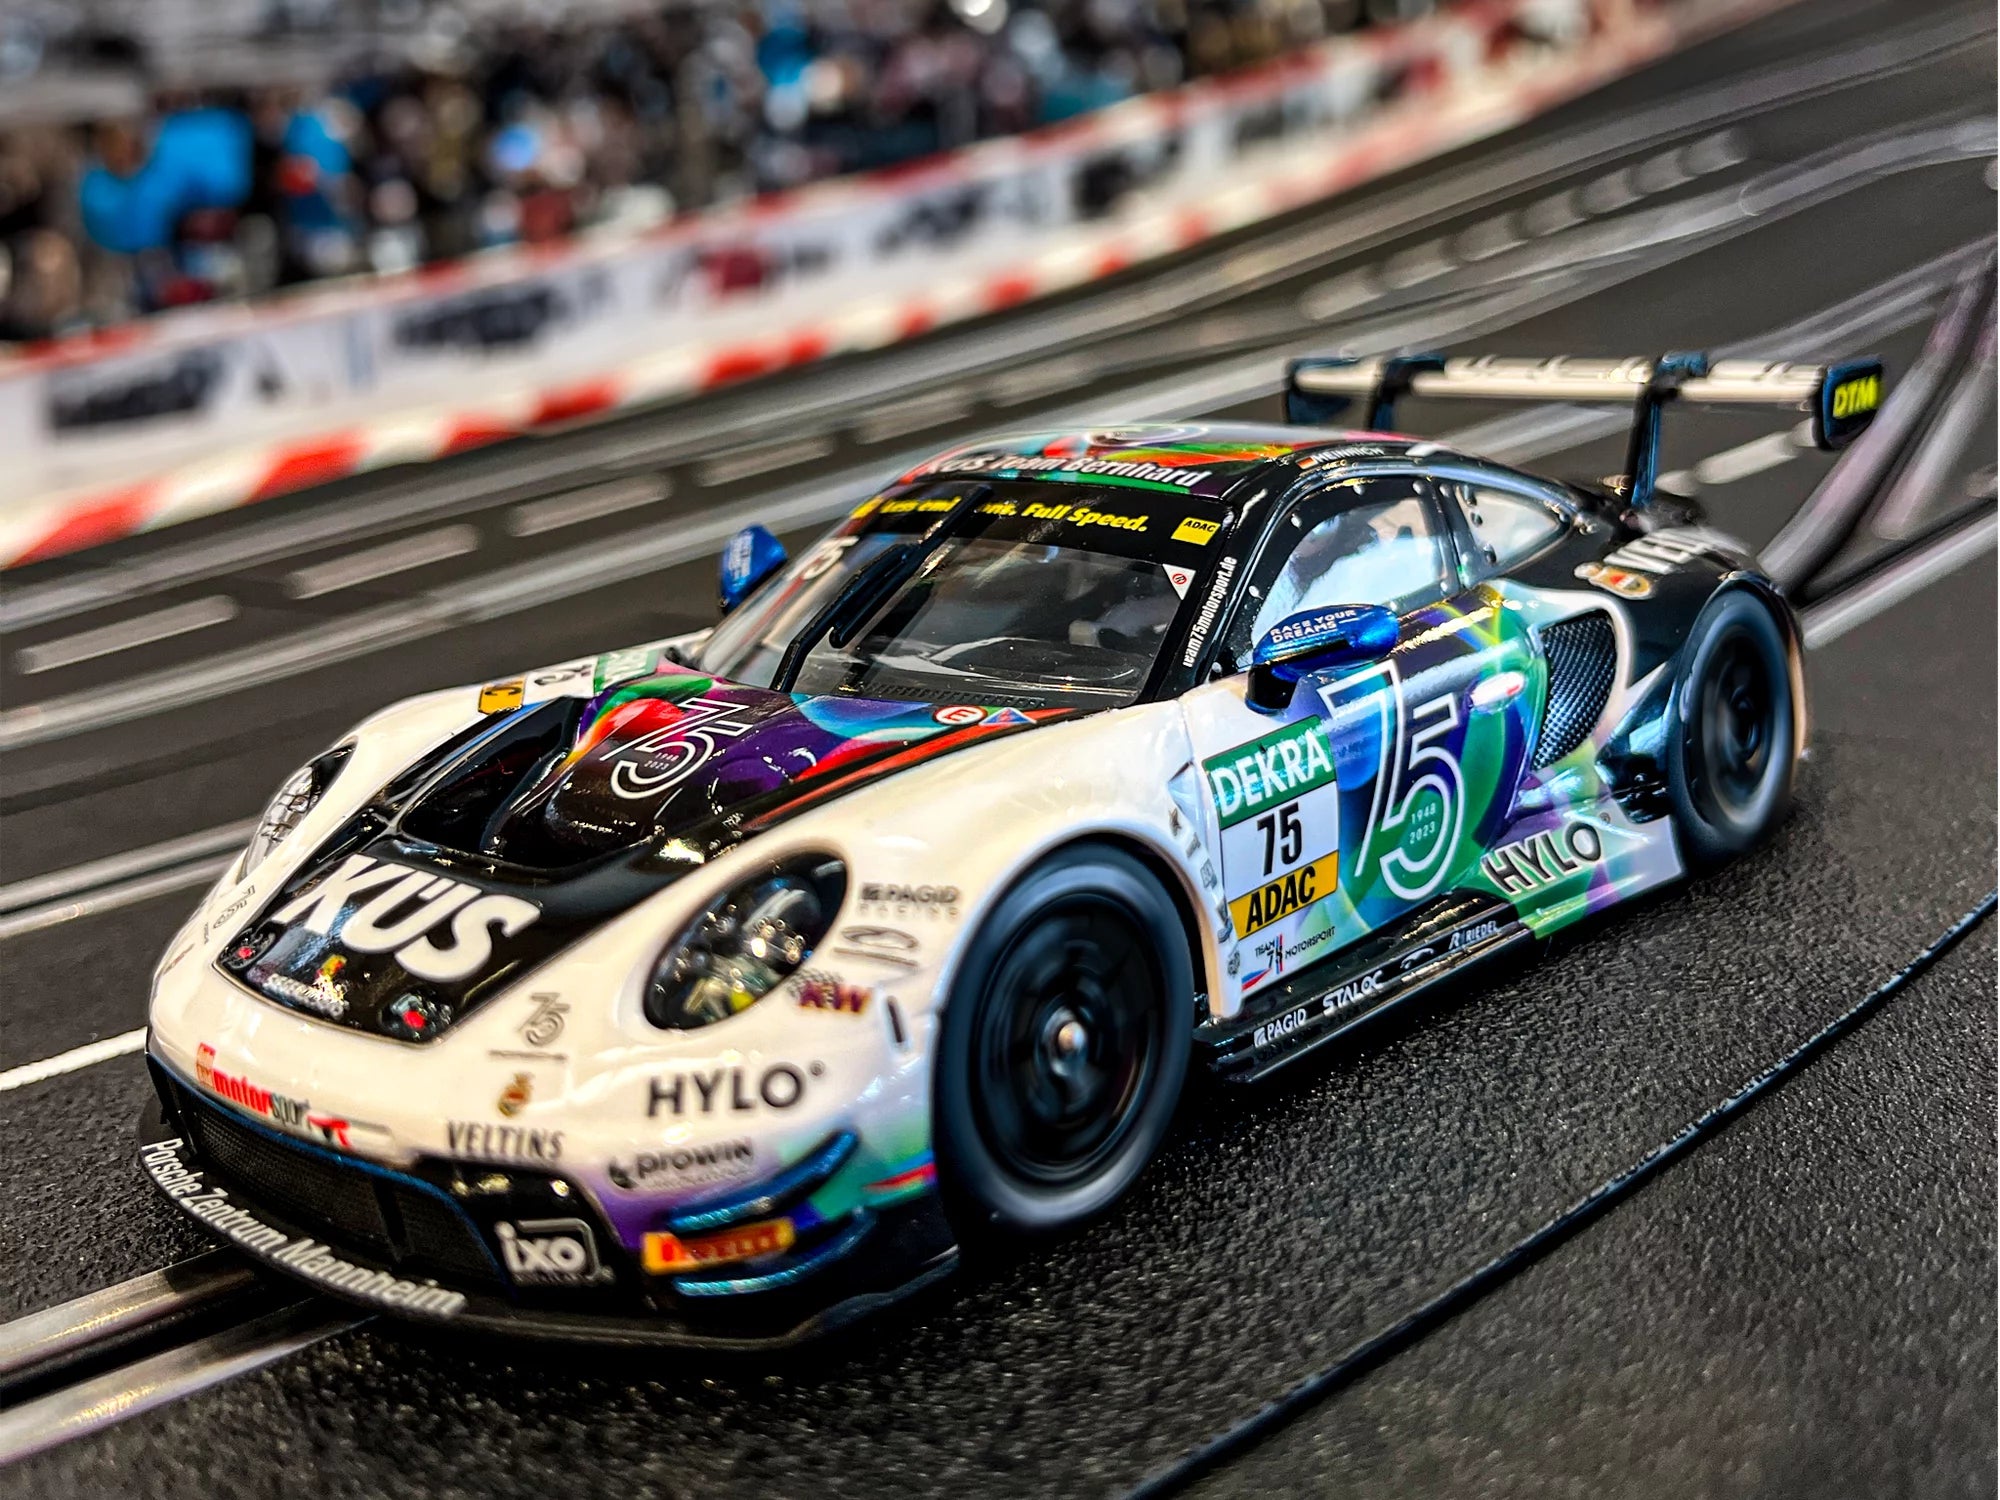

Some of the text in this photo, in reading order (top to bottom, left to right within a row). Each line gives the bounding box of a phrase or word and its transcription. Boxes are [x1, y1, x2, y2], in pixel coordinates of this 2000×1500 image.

[1833, 374, 1880, 419] DTM
[987, 454, 1067, 472] Team
[1066, 457, 1213, 488] Bernhard
[1021, 503, 1066, 519] Full
[1068, 508, 1148, 532] Speed.
[1183, 519, 1217, 534] ADAC
[1270, 609, 1357, 637] RACE YOUR
[1272, 621, 1338, 643] DREAMS
[598, 697, 754, 800] 75
[1210, 729, 1332, 818] DEKRA
[1316, 658, 1465, 900] 75
[1409, 820, 1436, 845] 2023
[1411, 802, 1437, 825] 1948
[1257, 802, 1303, 877] 75
[1480, 820, 1602, 896] HYLO
[271, 853, 541, 984] KÜS
[1246, 865, 1317, 934] ADAC
[1254, 940, 1276, 957] TEAM
[1285, 926, 1337, 960] MOTORSPORT
[1322, 969, 1384, 1017] STALOC
[1266, 1007, 1308, 1043] PAGID
[646, 1062, 806, 1119] HYLO
[446, 1119, 567, 1161] VELTINS
[141, 1137, 467, 1318] Porsche Zentrum Mannheim
[494, 1220, 585, 1274] ixo
